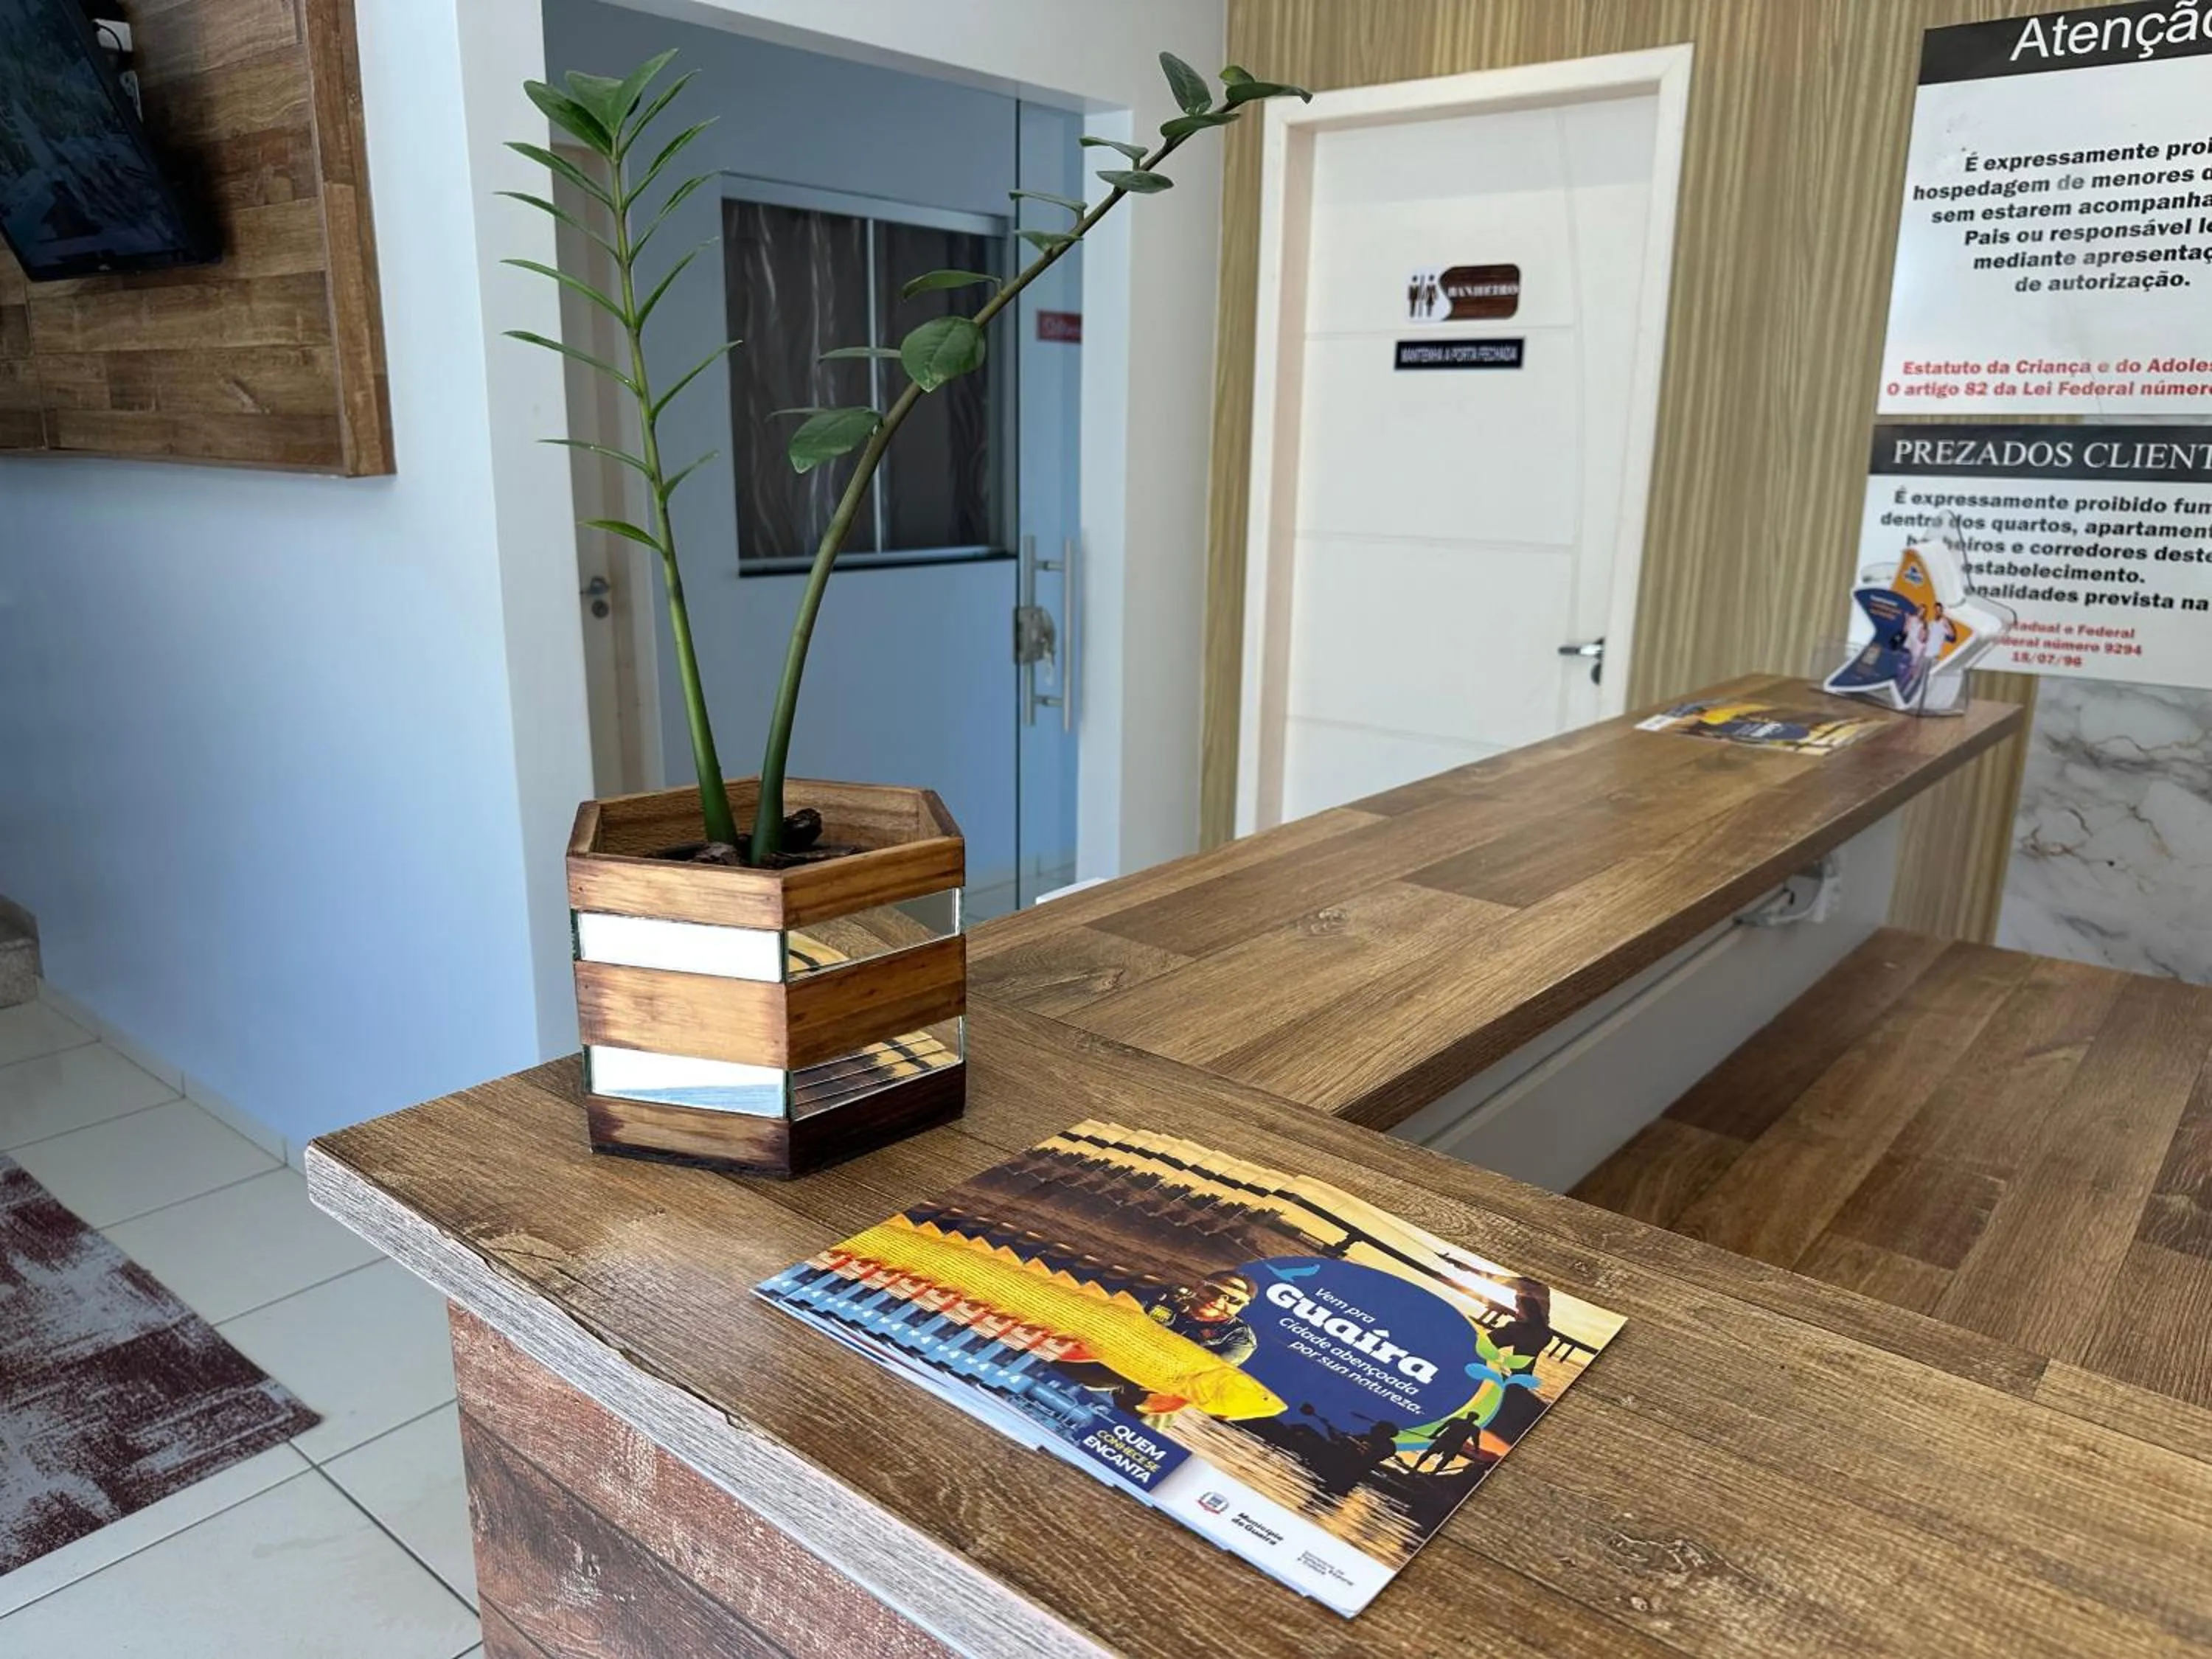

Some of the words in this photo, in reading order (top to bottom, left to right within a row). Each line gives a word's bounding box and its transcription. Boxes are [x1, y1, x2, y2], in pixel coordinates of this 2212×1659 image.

[1964, 152, 1979, 172] É
[1983, 143, 2159, 173] expressamente
[1913, 177, 2050, 201] hospedagem
[2056, 175, 2085, 191] de
[2091, 169, 2194, 189] menores
[1931, 207, 1975, 223] sem
[1981, 201, 2072, 220] estarem
[1964, 227, 2010, 246] Pais
[2016, 228, 2042, 243] ou
[2050, 218, 2192, 243] responsável
[1972, 251, 2076, 269] mediante
[2014, 276, 2042, 293] de
[2048, 269, 2191, 293] autorização.
[1902, 361, 1981, 376] Estatuto
[1986, 359, 2011, 375] da
[2016, 359, 2092, 378] Criança
[2096, 362, 2110, 373] e
[2115, 358, 2141, 373] do
[2146, 357, 2212, 373] Adole
[1886, 383, 1901, 396] O
[1904, 380, 1960, 398] artigo
[1964, 382, 1988, 396] 82
[1993, 381, 2017, 396] da
[2022, 381, 2052, 396] Lei
[2057, 380, 2134, 395] Federal
[2140, 380, 2212, 395] númer
[1893, 439, 2073, 467] PREZADOS
[1894, 487, 1907, 504] É
[1911, 493, 2069, 511] expressamente
[2075, 494, 2167, 514] proibido
[1881, 512, 1943, 527] dentro
[1949, 515, 1986, 529] dos
[1991, 519, 2079, 536] quartos,
[2011, 541, 2024, 554] e
[2030, 540, 2147, 560] corredores
[1961, 561, 2145, 583] estabelecimento.
[1964, 584, 2079, 603] enalidades
[2084, 592, 2174, 609] prevista
[2180, 598, 2209, 611] na
[2077, 625, 2135, 639] Federal
[2042, 639, 2101, 653] número
[1315, 1287, 1348, 1310] Vem
[1344, 1306, 1377, 1324] pra
[1266, 1283, 1439, 1384] Guaíra
[1279, 1317, 1331, 1349] Cidade
[1330, 1346, 1419, 1395] abençoada
[1288, 1340, 1321, 1362] por
[1320, 1355, 1349, 1374] sua
[1348, 1371, 1424, 1415] natureza.
[1113, 1425, 1166, 1461] QUEM
[1082, 1436, 1151, 1484] ENCANTA
